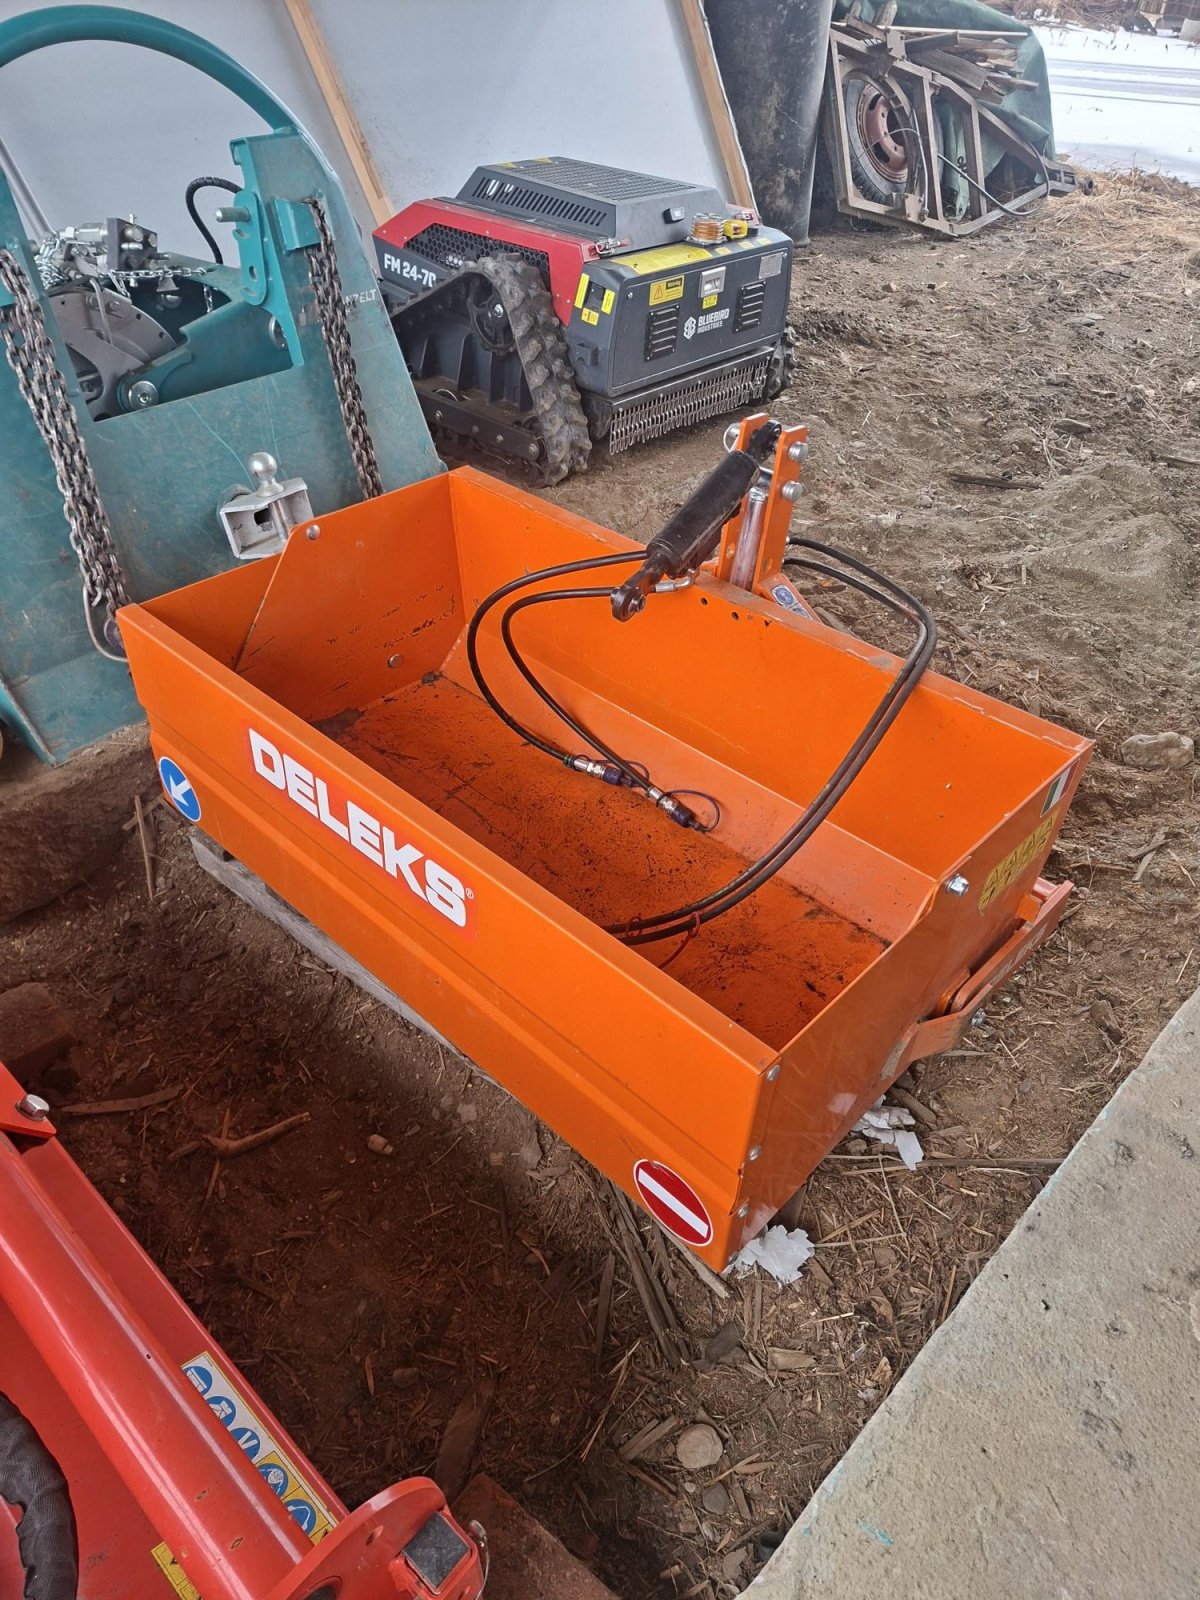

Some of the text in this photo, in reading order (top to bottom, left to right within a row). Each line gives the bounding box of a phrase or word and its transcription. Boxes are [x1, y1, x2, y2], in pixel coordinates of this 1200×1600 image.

[384, 253, 401, 274] FM
[697, 320, 723, 334] INDUSTRIES
[698, 308, 730, 327] BLUEBIRD
